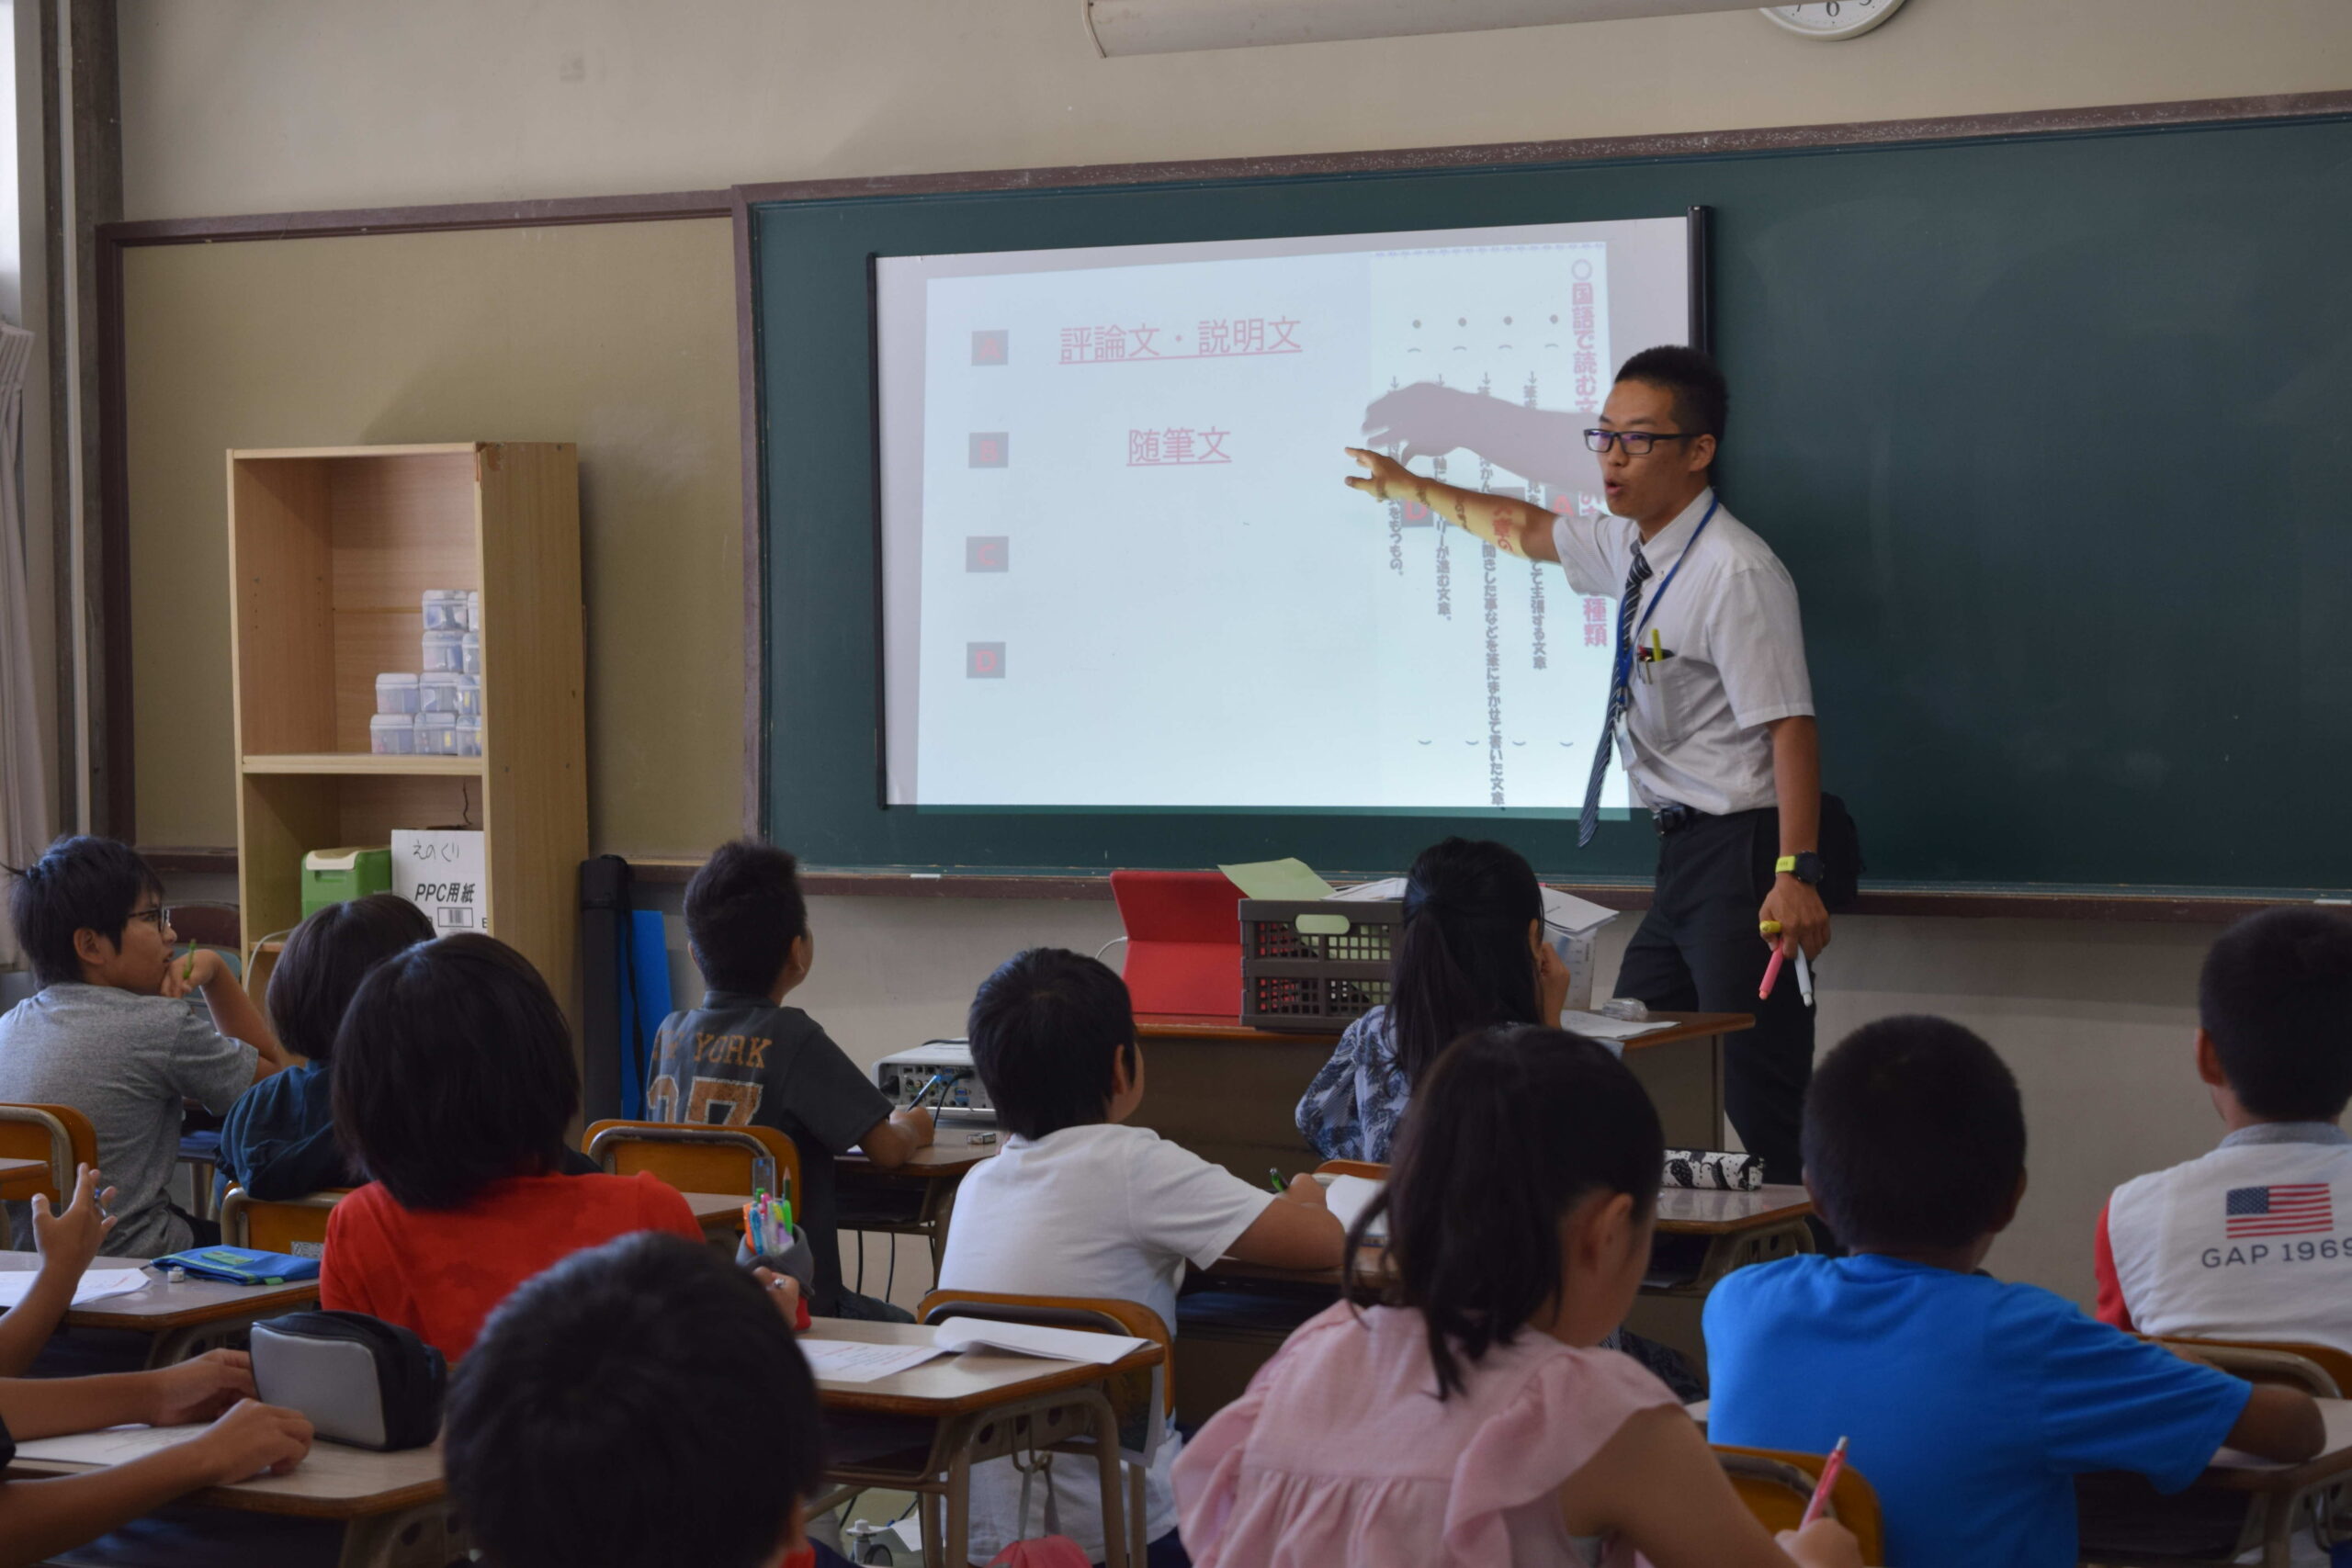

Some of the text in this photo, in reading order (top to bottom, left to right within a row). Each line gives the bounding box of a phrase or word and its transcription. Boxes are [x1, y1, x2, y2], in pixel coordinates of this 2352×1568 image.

[1059, 315, 1302, 362] 評論文・説明文
[1127, 425, 1233, 464] 随筆文
[978, 544, 996, 567] C
[975, 649, 997, 672] D
[414, 882, 476, 903] PPC用紙
[694, 1032, 773, 1069] YORK
[2201, 1244, 2269, 1269] GAP
